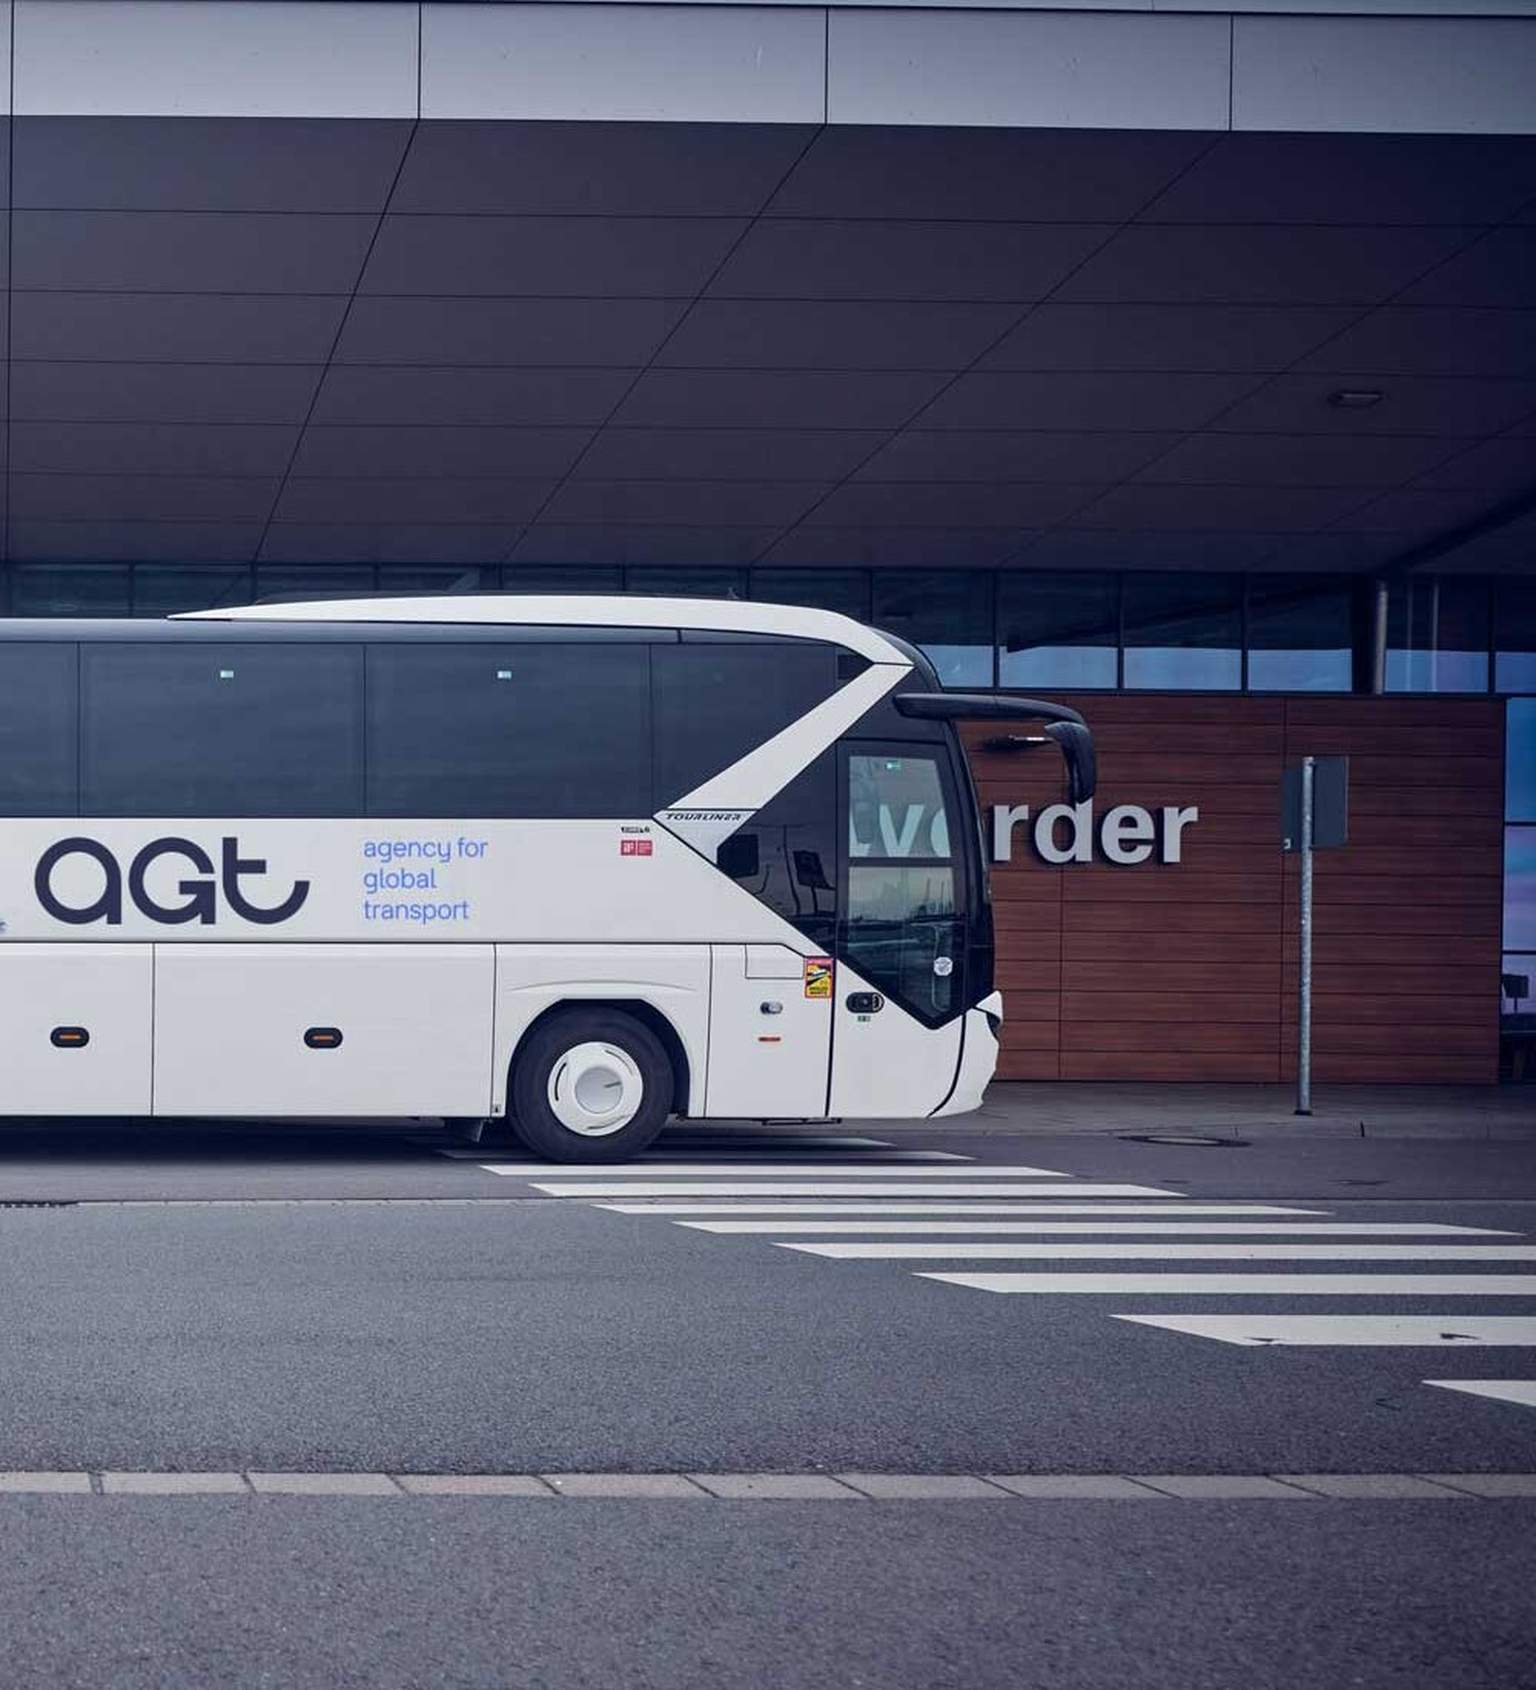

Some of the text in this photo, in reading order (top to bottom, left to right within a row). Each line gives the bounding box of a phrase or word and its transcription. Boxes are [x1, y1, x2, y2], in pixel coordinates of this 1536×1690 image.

[363, 836, 489, 863] agency for
[363, 867, 438, 894] global
[363, 900, 470, 923] transport
